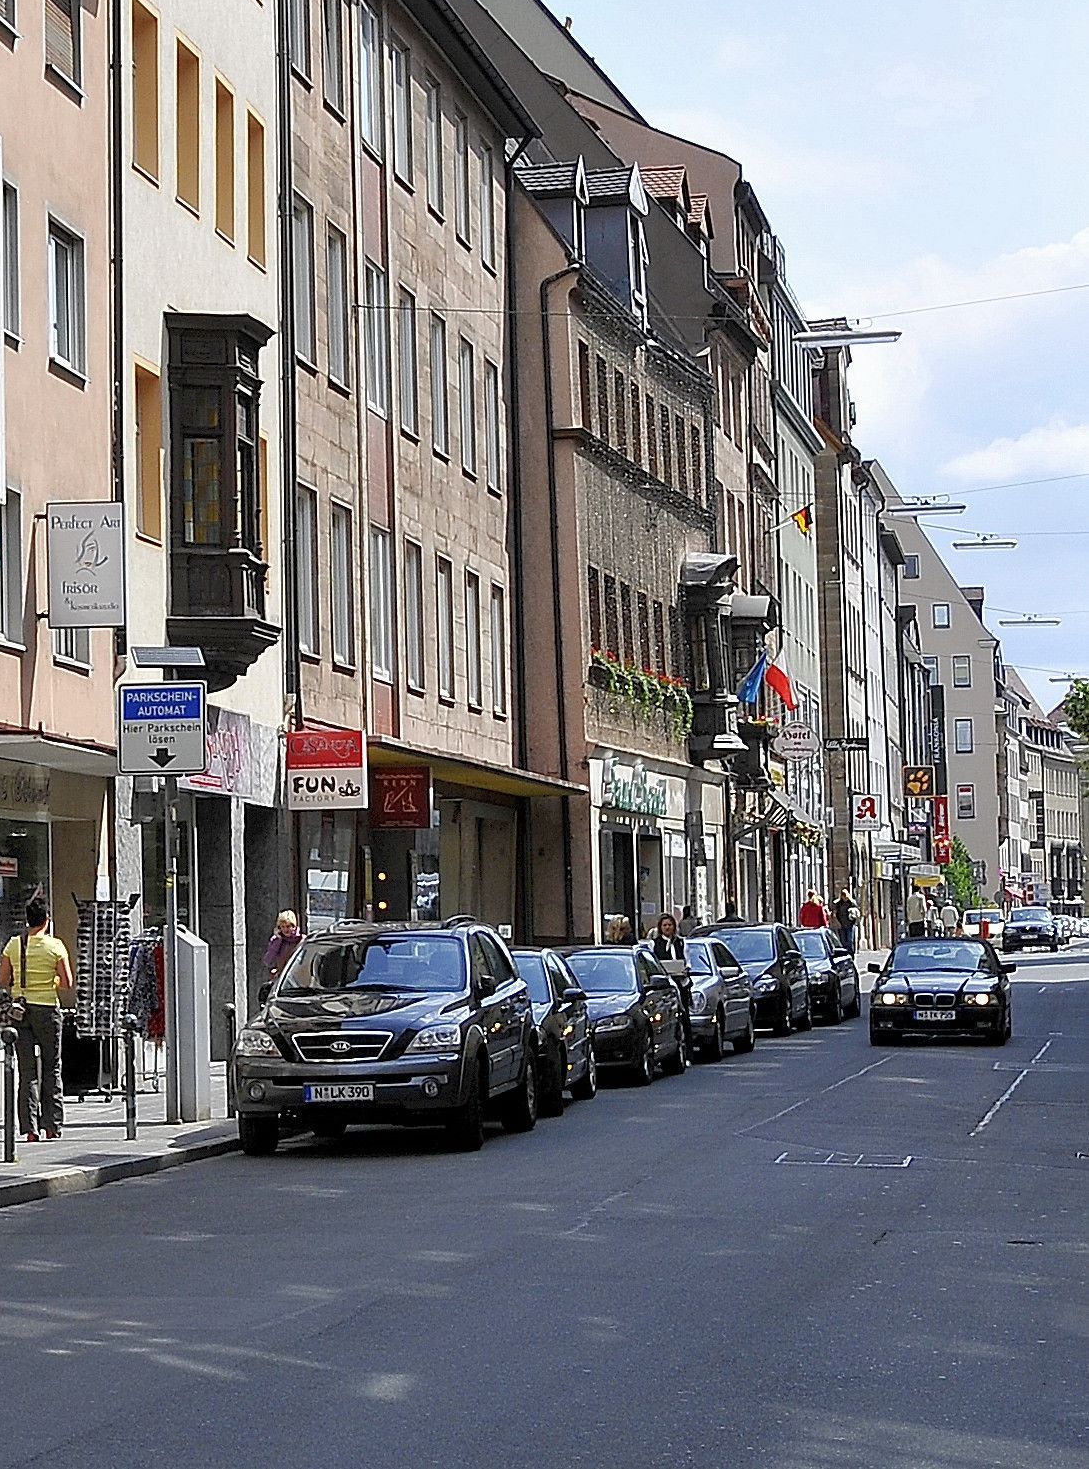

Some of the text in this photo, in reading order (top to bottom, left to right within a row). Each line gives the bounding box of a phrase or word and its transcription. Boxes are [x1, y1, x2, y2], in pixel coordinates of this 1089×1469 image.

[126, 691, 197, 703] PARKSCHEIN-
[137, 705, 186, 716] AUTOMAT
[123, 721, 201, 734] Hier Parkschein
[148, 735, 176, 744] lösen
[292, 775, 337, 794] FUN
[293, 795, 336, 803] FACTORY
[314, 1086, 370, 1099] N LK 390
